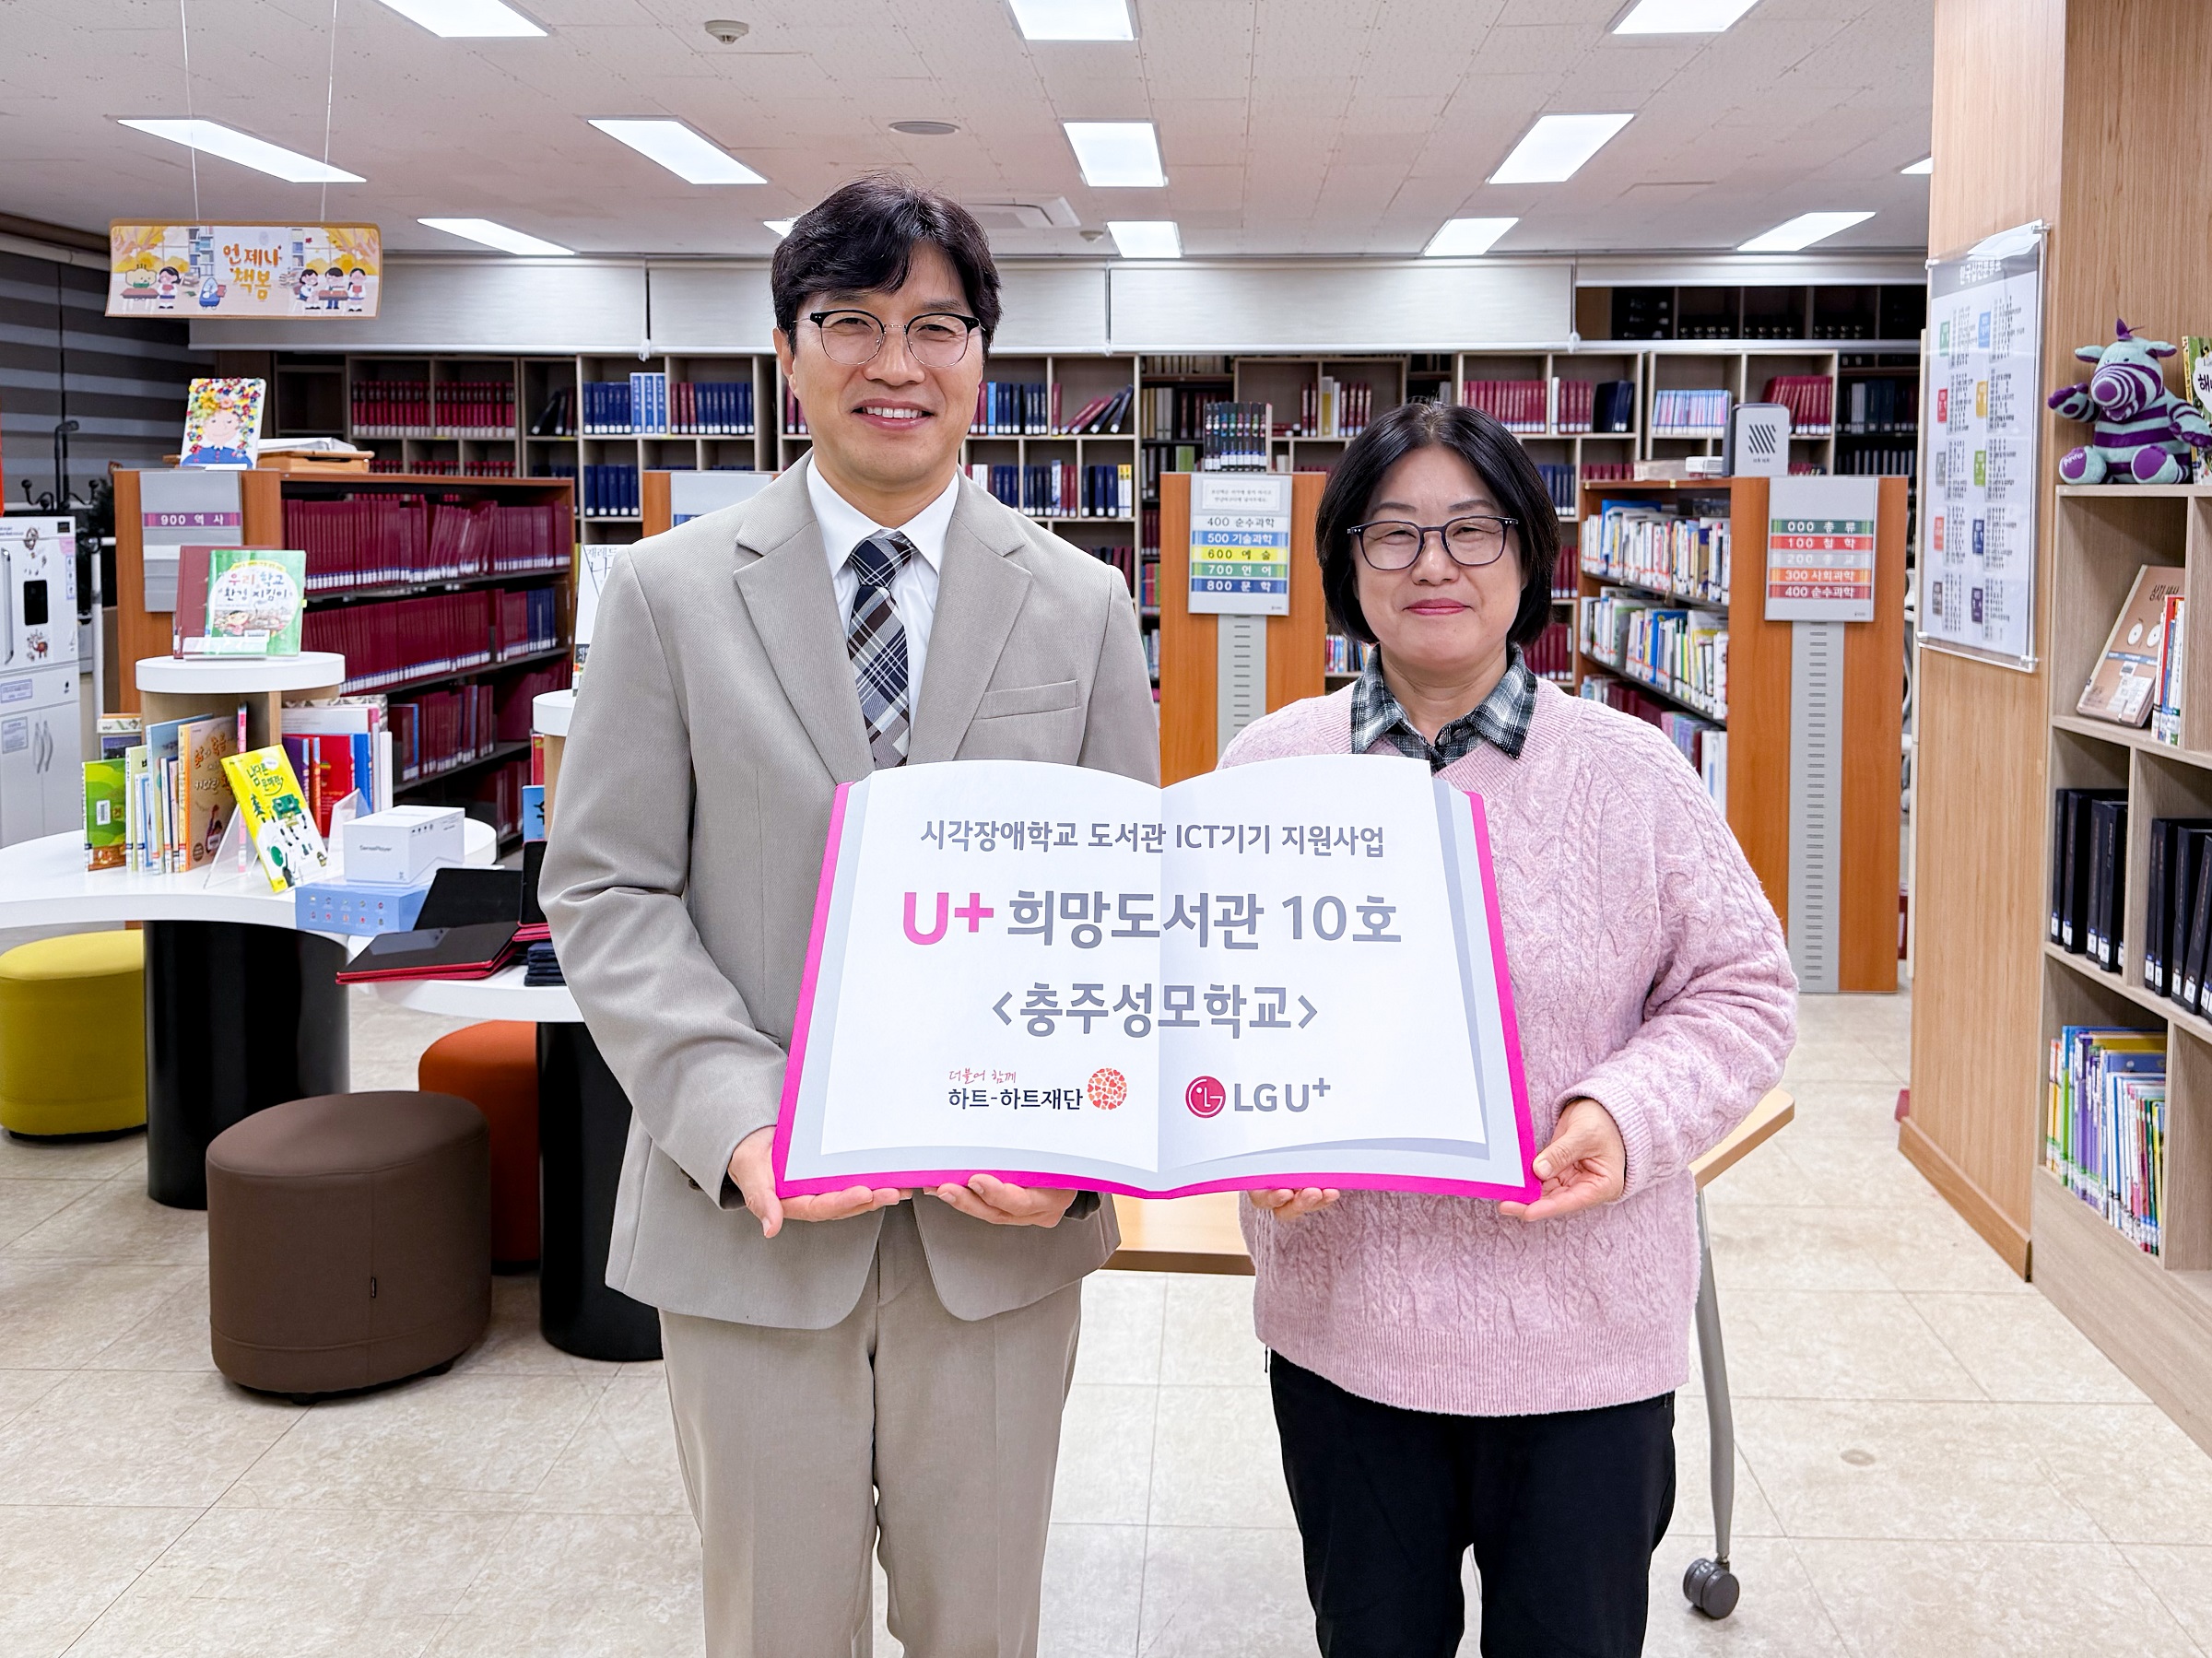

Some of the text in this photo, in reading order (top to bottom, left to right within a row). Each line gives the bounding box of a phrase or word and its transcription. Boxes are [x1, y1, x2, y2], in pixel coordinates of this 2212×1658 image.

[223, 243, 278, 266] 언제나
[2198, 373, 2212, 393] 해
[160, 514, 186, 525] 900
[1207, 517, 1275, 528] 400 순수과학
[1787, 522, 1815, 533] 000
[1207, 534, 1273, 545] 500 기술과학
[1788, 537, 1814, 548] 100
[1207, 549, 1232, 559] 600
[1787, 554, 1813, 565] 200
[1208, 565, 1233, 575] 700
[1785, 570, 1854, 582] 300 사회과학
[229, 571, 285, 587] 우리 학교
[1206, 581, 1232, 591] 800
[253, 589, 287, 602] 지킴이
[1785, 586, 1855, 599] 400 순수과학
[921, 820, 1383, 857] 시각장애학교 도서관 ICT기기 지원사업
[902, 890, 1402, 950] U+ 희망도서관 10호
[993, 982, 1318, 1039] <충주성모학교>
[949, 1068, 1017, 1084] 더불어 함께
[948, 1088, 1083, 1110] 하트-하트재단
